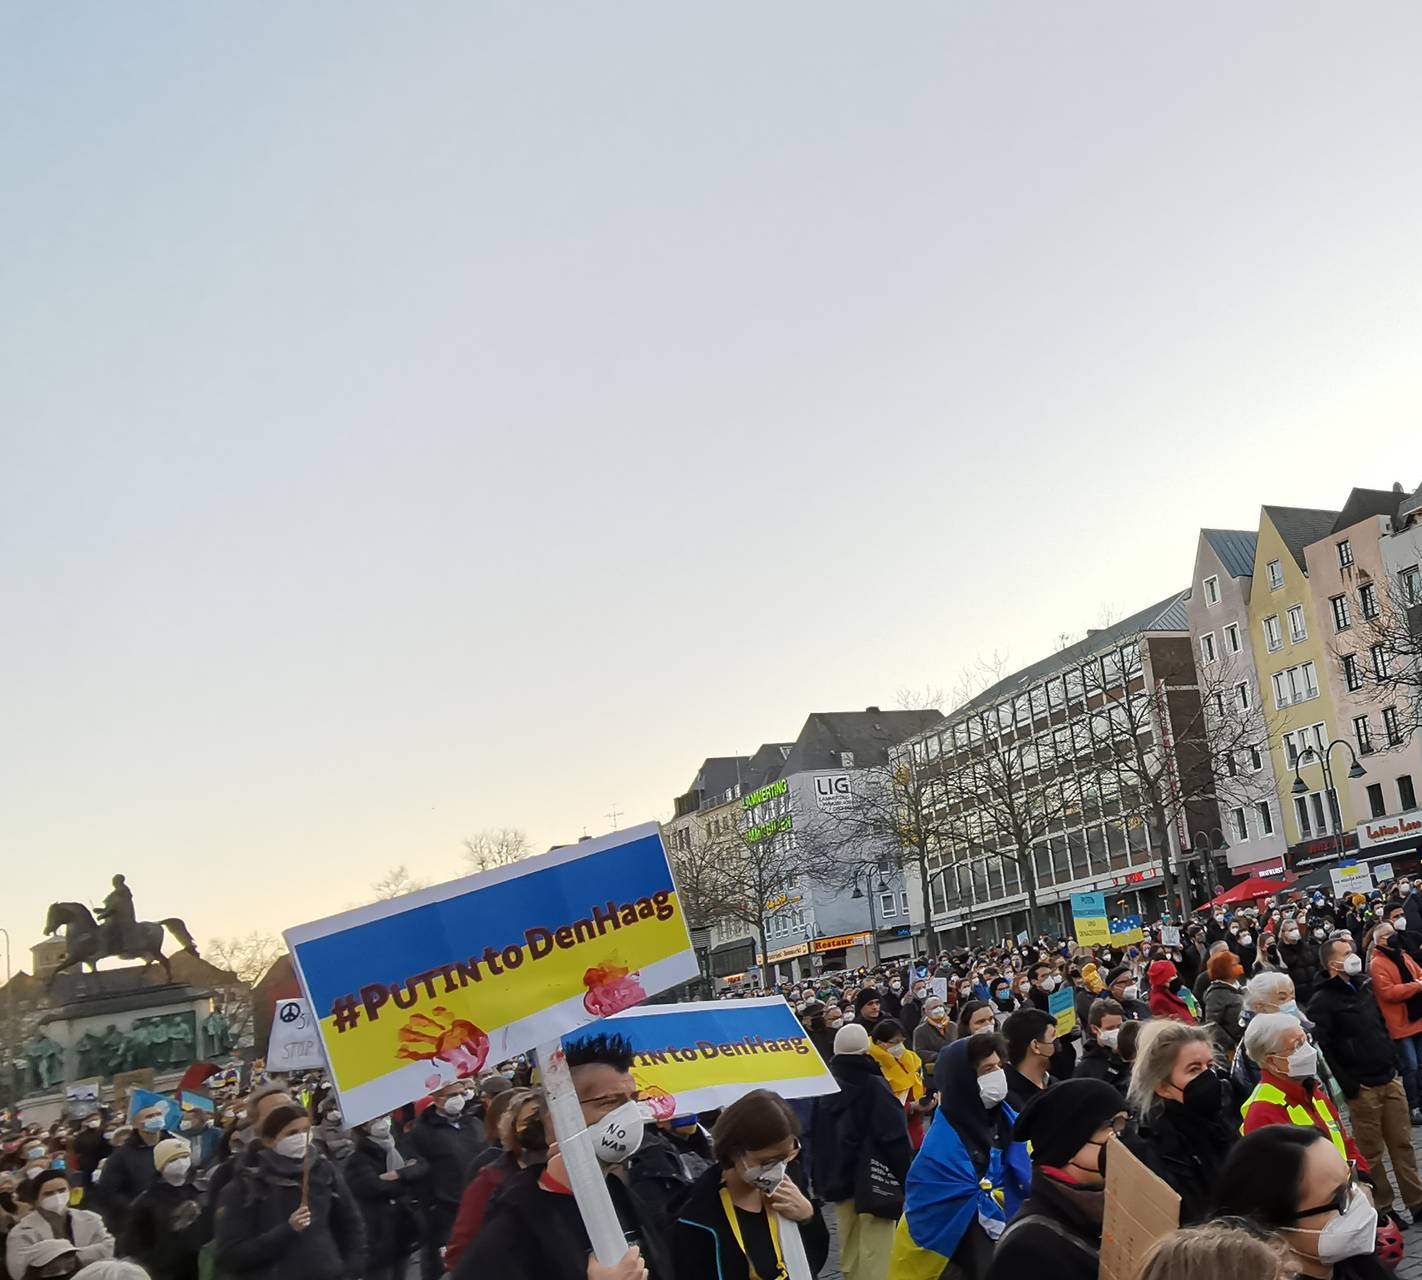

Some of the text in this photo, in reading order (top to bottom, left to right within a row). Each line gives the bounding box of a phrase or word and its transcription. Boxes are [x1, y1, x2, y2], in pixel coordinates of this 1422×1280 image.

[817, 777, 851, 796] LIG
[607, 1122, 626, 1139] NO
[601, 1136, 626, 1152] WAR
